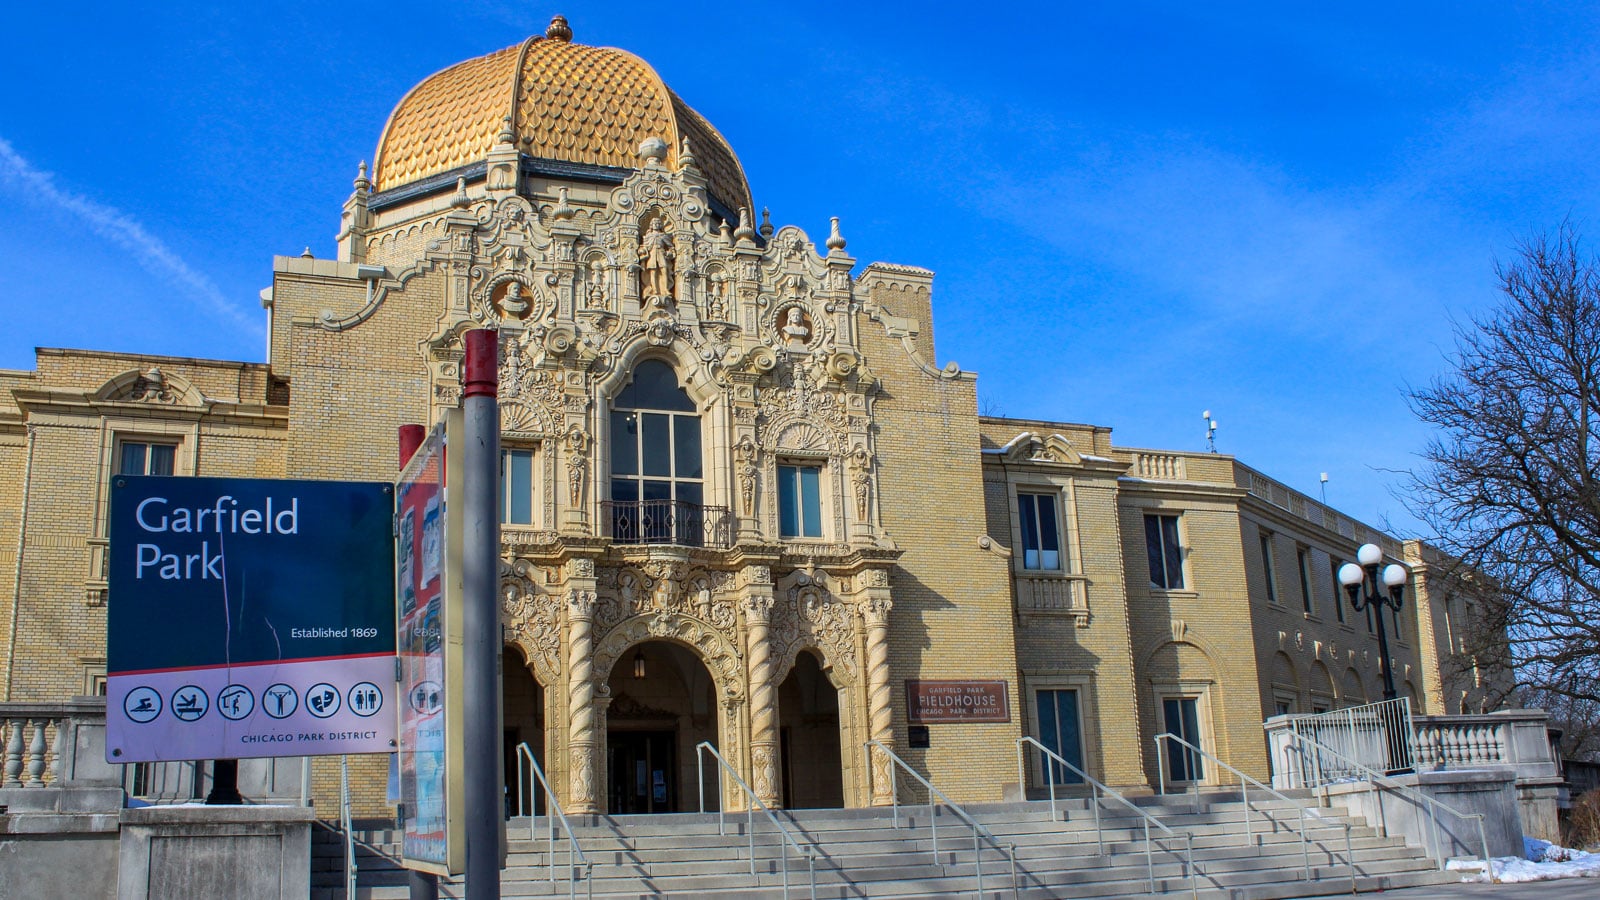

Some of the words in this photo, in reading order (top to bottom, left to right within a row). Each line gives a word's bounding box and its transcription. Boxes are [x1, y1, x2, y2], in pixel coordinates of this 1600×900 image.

[136, 495, 298, 534] Garfield
[136, 541, 223, 580] Park
[291, 627, 348, 638] Established
[350, 628, 378, 638] 1869
[918, 695, 997, 707] FIELDHOUSE
[973, 707, 1001, 715] DISTRICT
[241, 734, 293, 744] CHICAGO
[298, 733, 325, 741] PARK
[329, 731, 377, 740] DISTRICT
